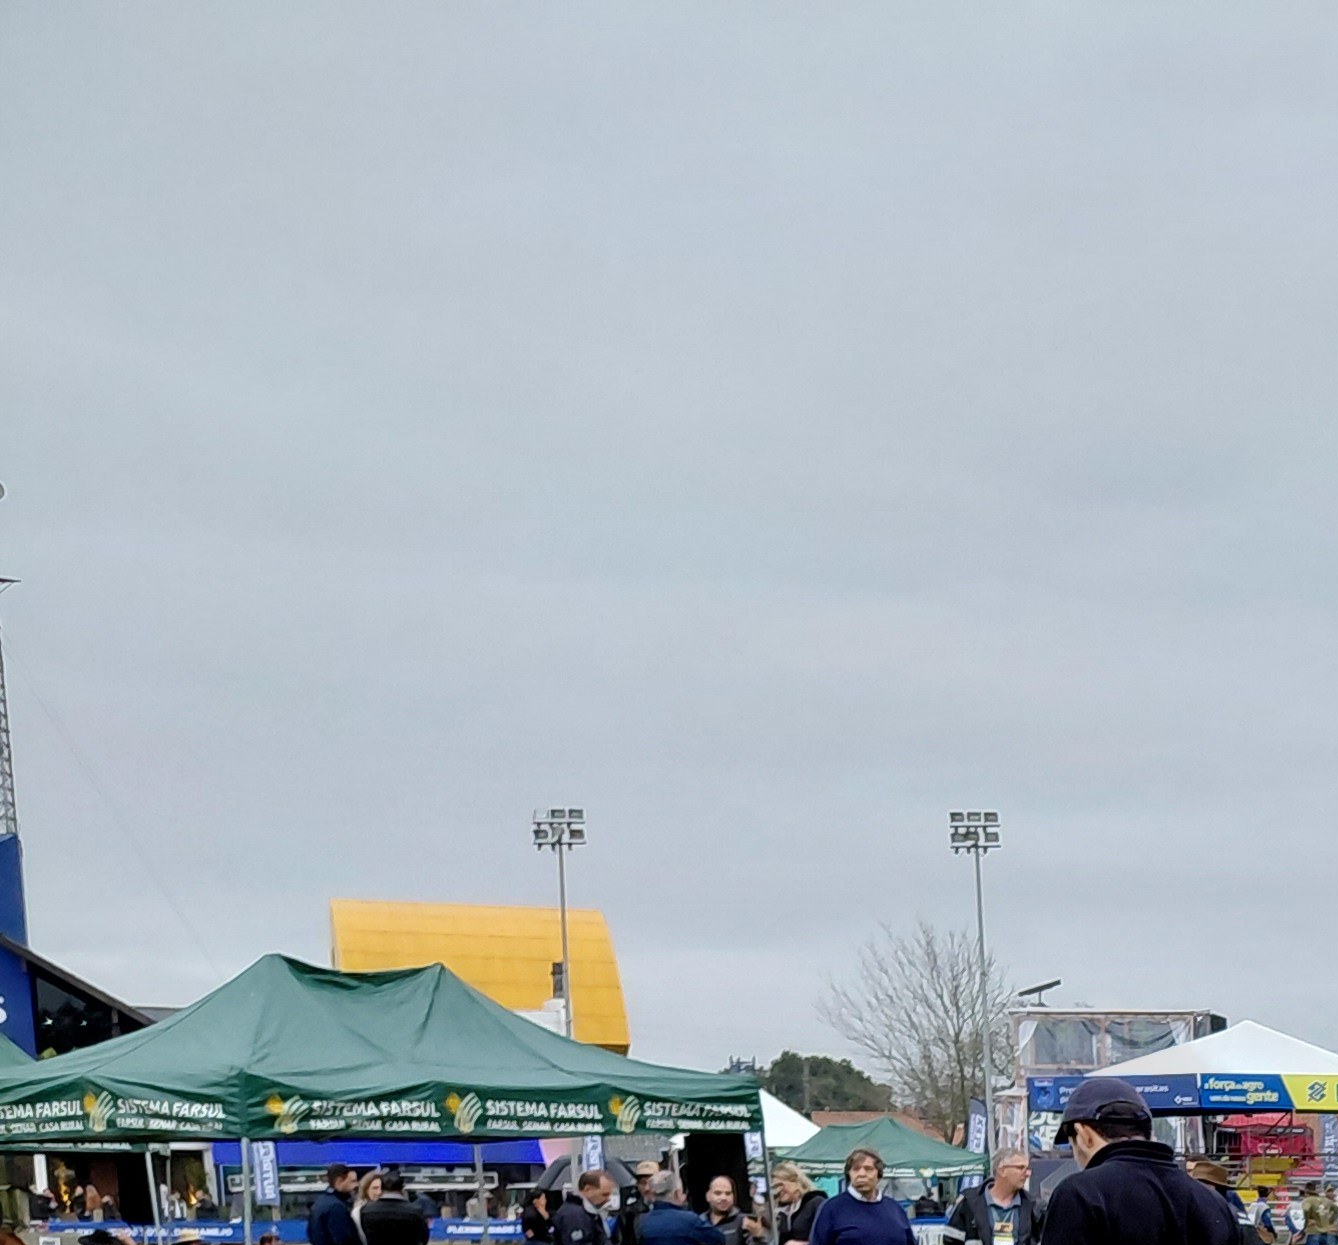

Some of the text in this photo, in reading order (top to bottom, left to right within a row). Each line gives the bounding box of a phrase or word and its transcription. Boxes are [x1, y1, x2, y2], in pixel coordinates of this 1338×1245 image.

[1208, 1077, 1236, 1091] força
[1246, 1090, 1279, 1105] gente
[35, 1100, 84, 1119] FARSUL
[117, 1098, 227, 1119] SISTEMA FARSUL
[311, 1099, 441, 1118] SISTEMA FARSUL
[485, 1099, 604, 1120] SISTEMA FARSUL
[643, 1101, 701, 1118] SISTEMA
